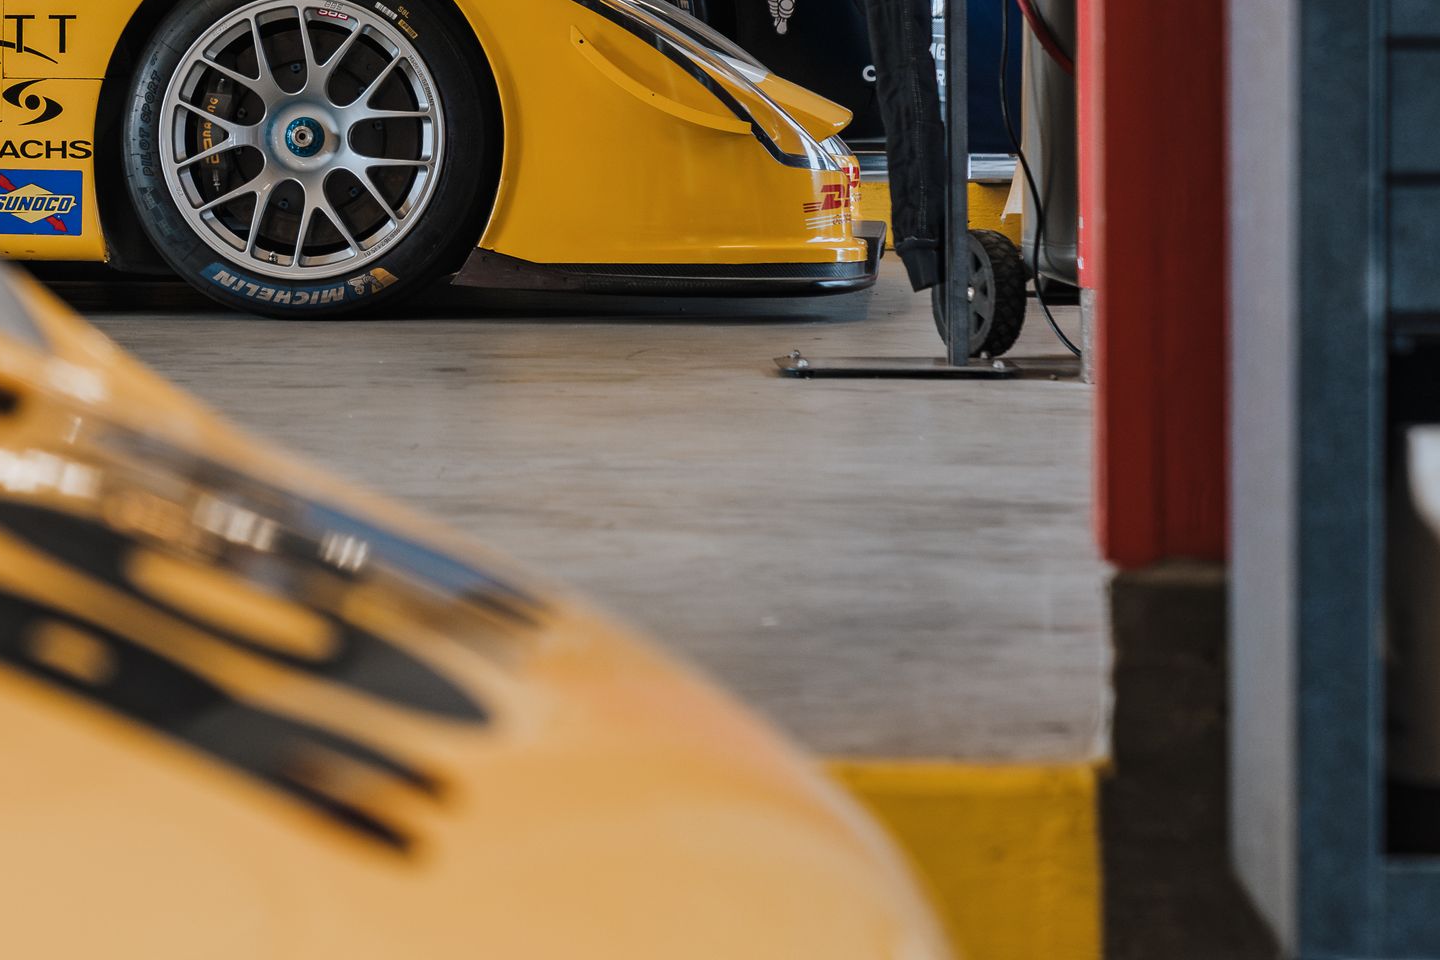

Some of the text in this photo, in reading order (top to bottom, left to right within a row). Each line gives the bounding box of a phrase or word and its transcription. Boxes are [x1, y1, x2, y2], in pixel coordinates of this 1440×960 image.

[139, 69, 161, 126] SPORT
[138, 127, 153, 177] PILOT
[212, 270, 345, 306] MICHELIN
